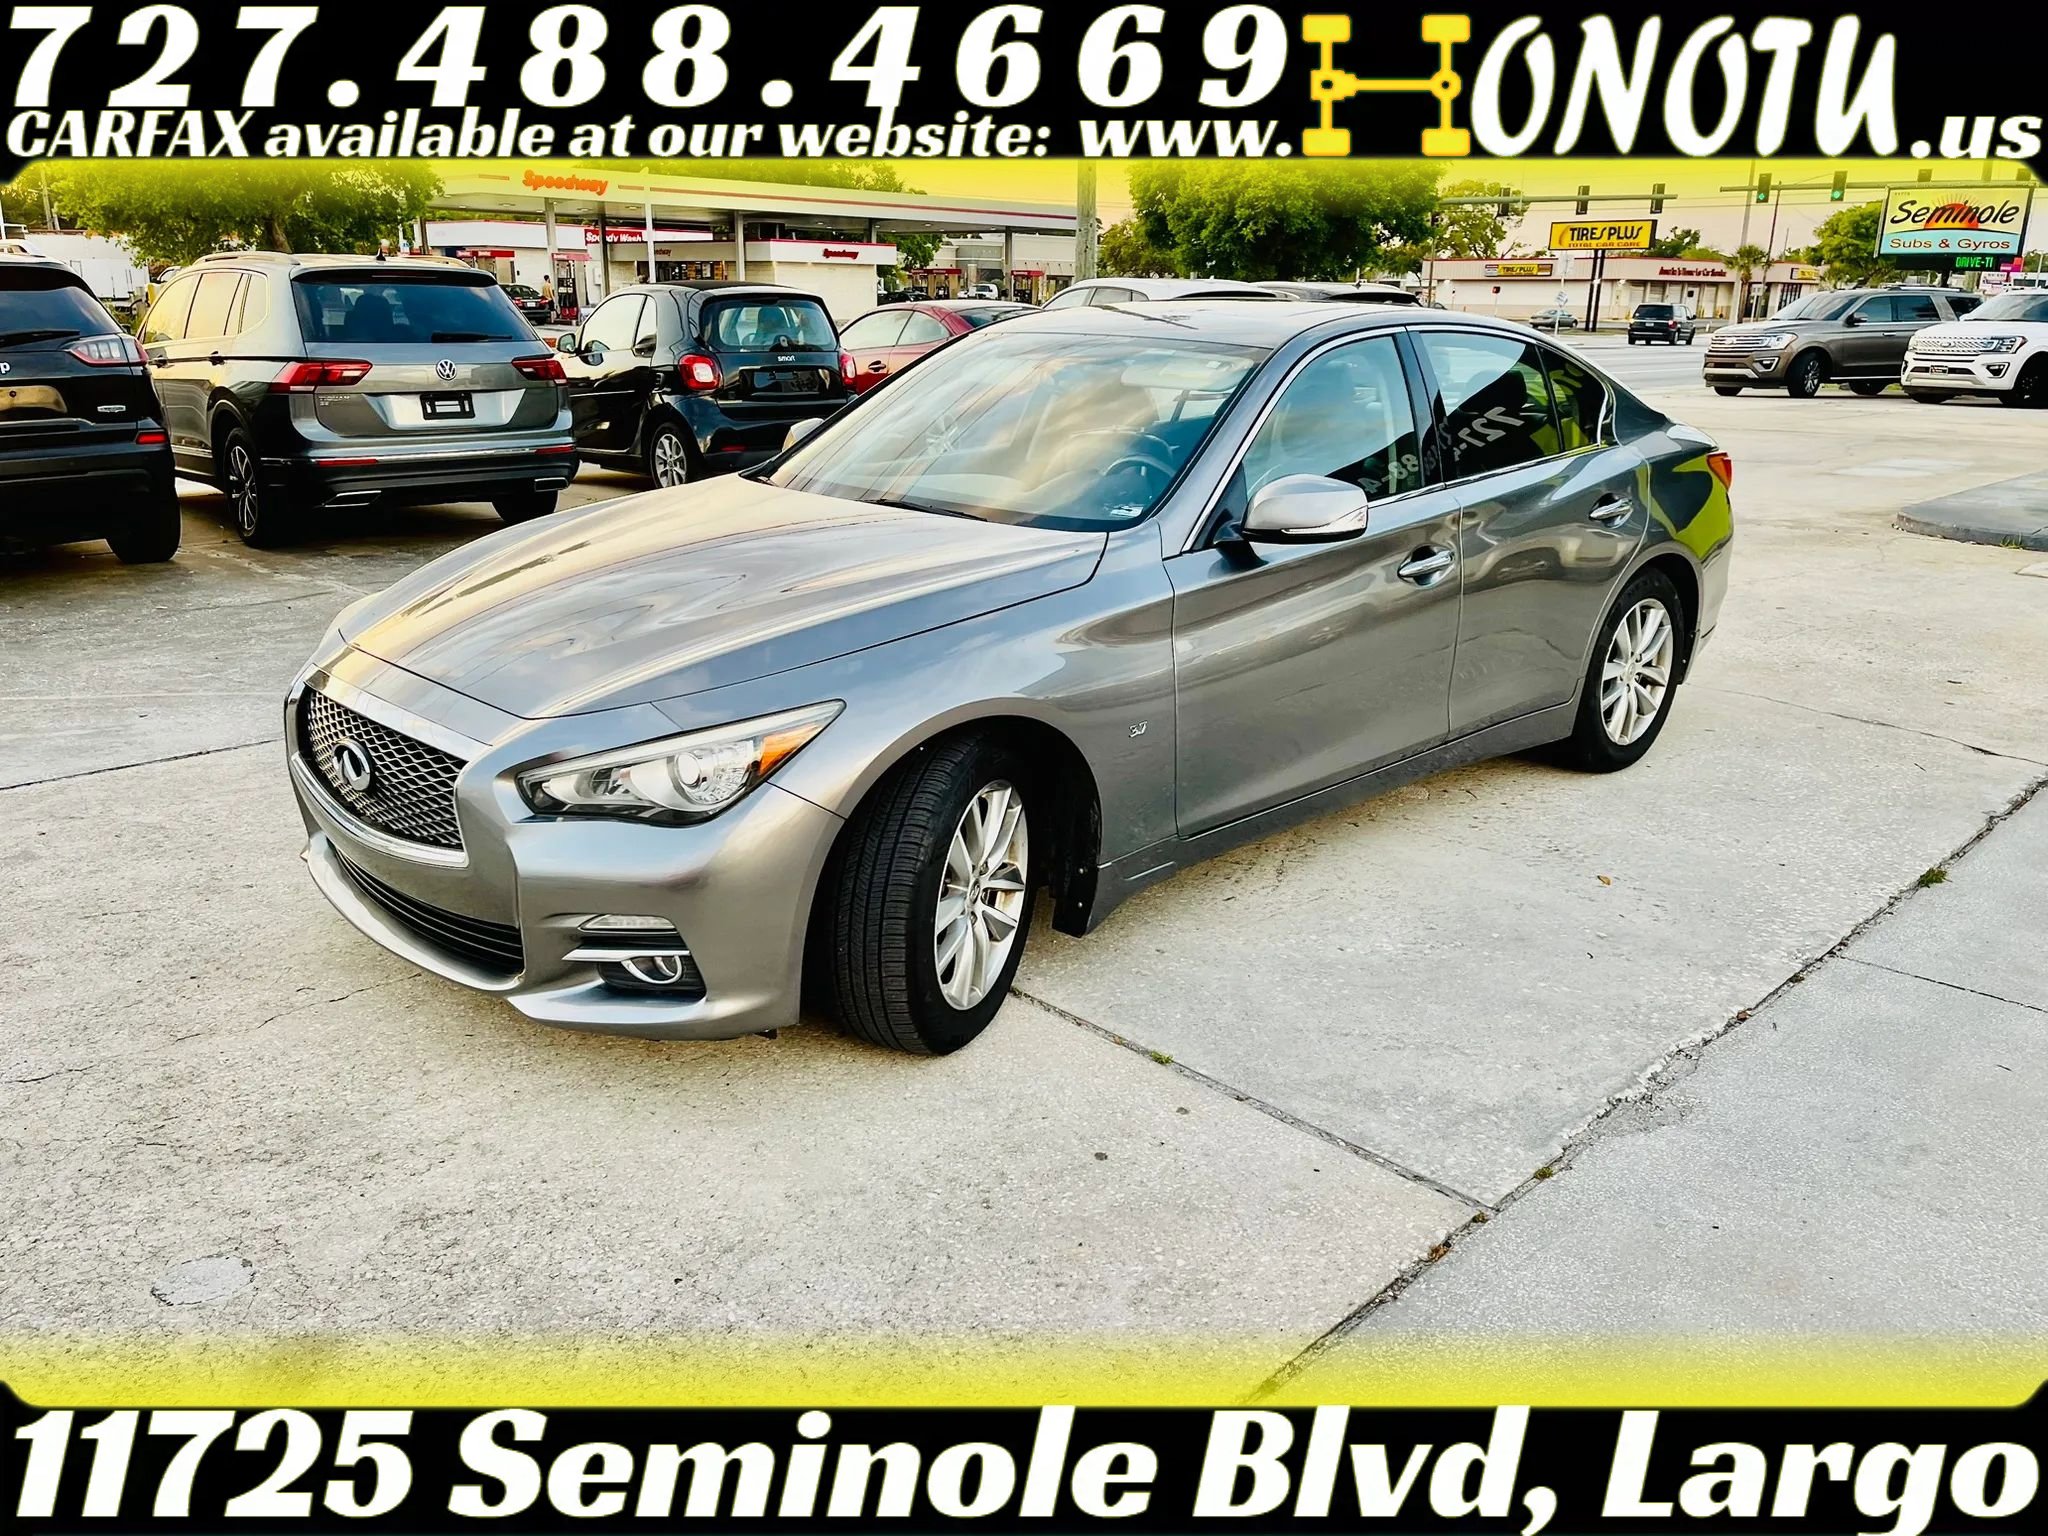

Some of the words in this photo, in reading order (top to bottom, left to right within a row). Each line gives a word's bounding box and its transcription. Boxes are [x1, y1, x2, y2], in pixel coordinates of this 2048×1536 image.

[523, 169, 608, 196] Speedway
[1890, 199, 2020, 224] Seminole
[586, 231, 619, 242] Spedy
[620, 233, 642, 242] Wash
[1890, 238, 1932, 249] Subs
[1938, 238, 1950, 249] &
[1957, 238, 2010, 251] Gyros
